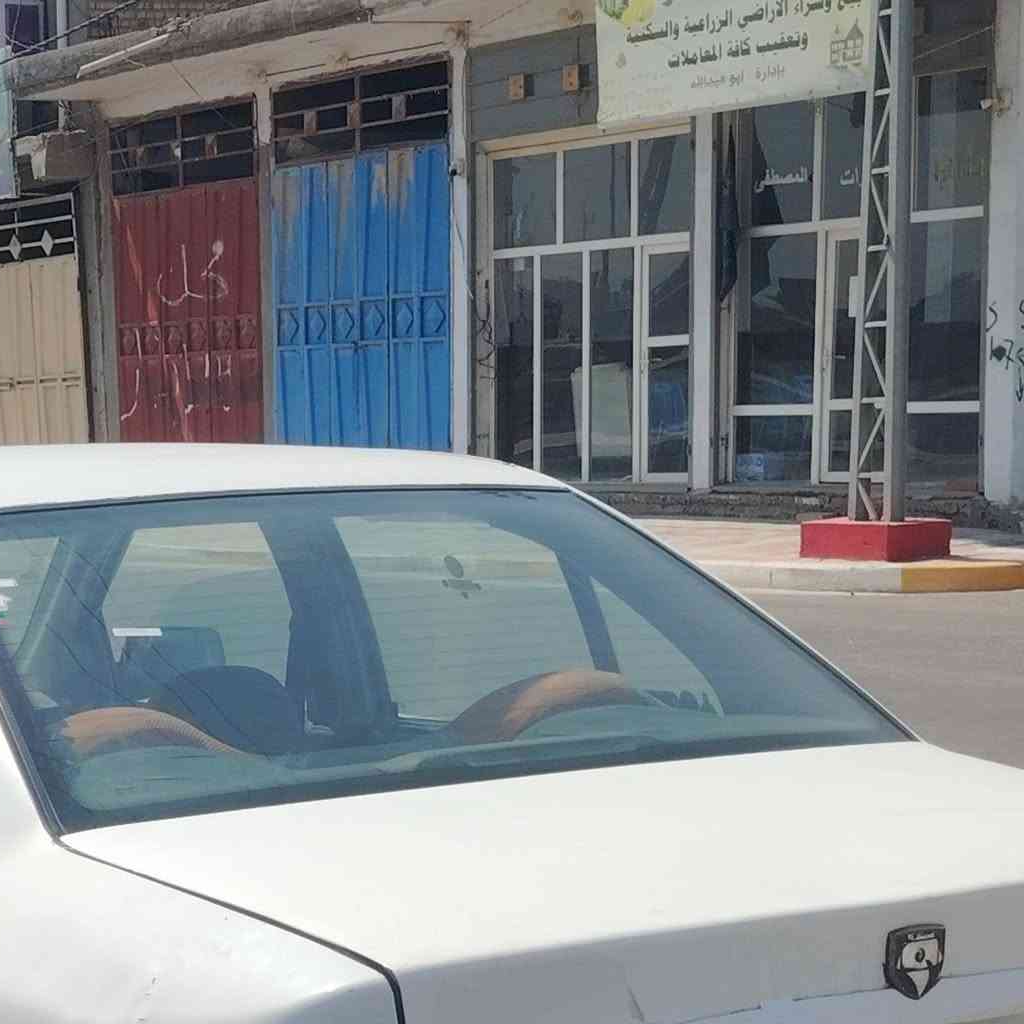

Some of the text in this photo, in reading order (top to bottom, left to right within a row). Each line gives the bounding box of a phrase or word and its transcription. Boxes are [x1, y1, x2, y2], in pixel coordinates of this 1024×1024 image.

[626, 16, 680, 45] والسكنية
[683, 7, 733, 37] الزراعية
[667, 31, 809, 69] وتعقيب كافة المعاملات
